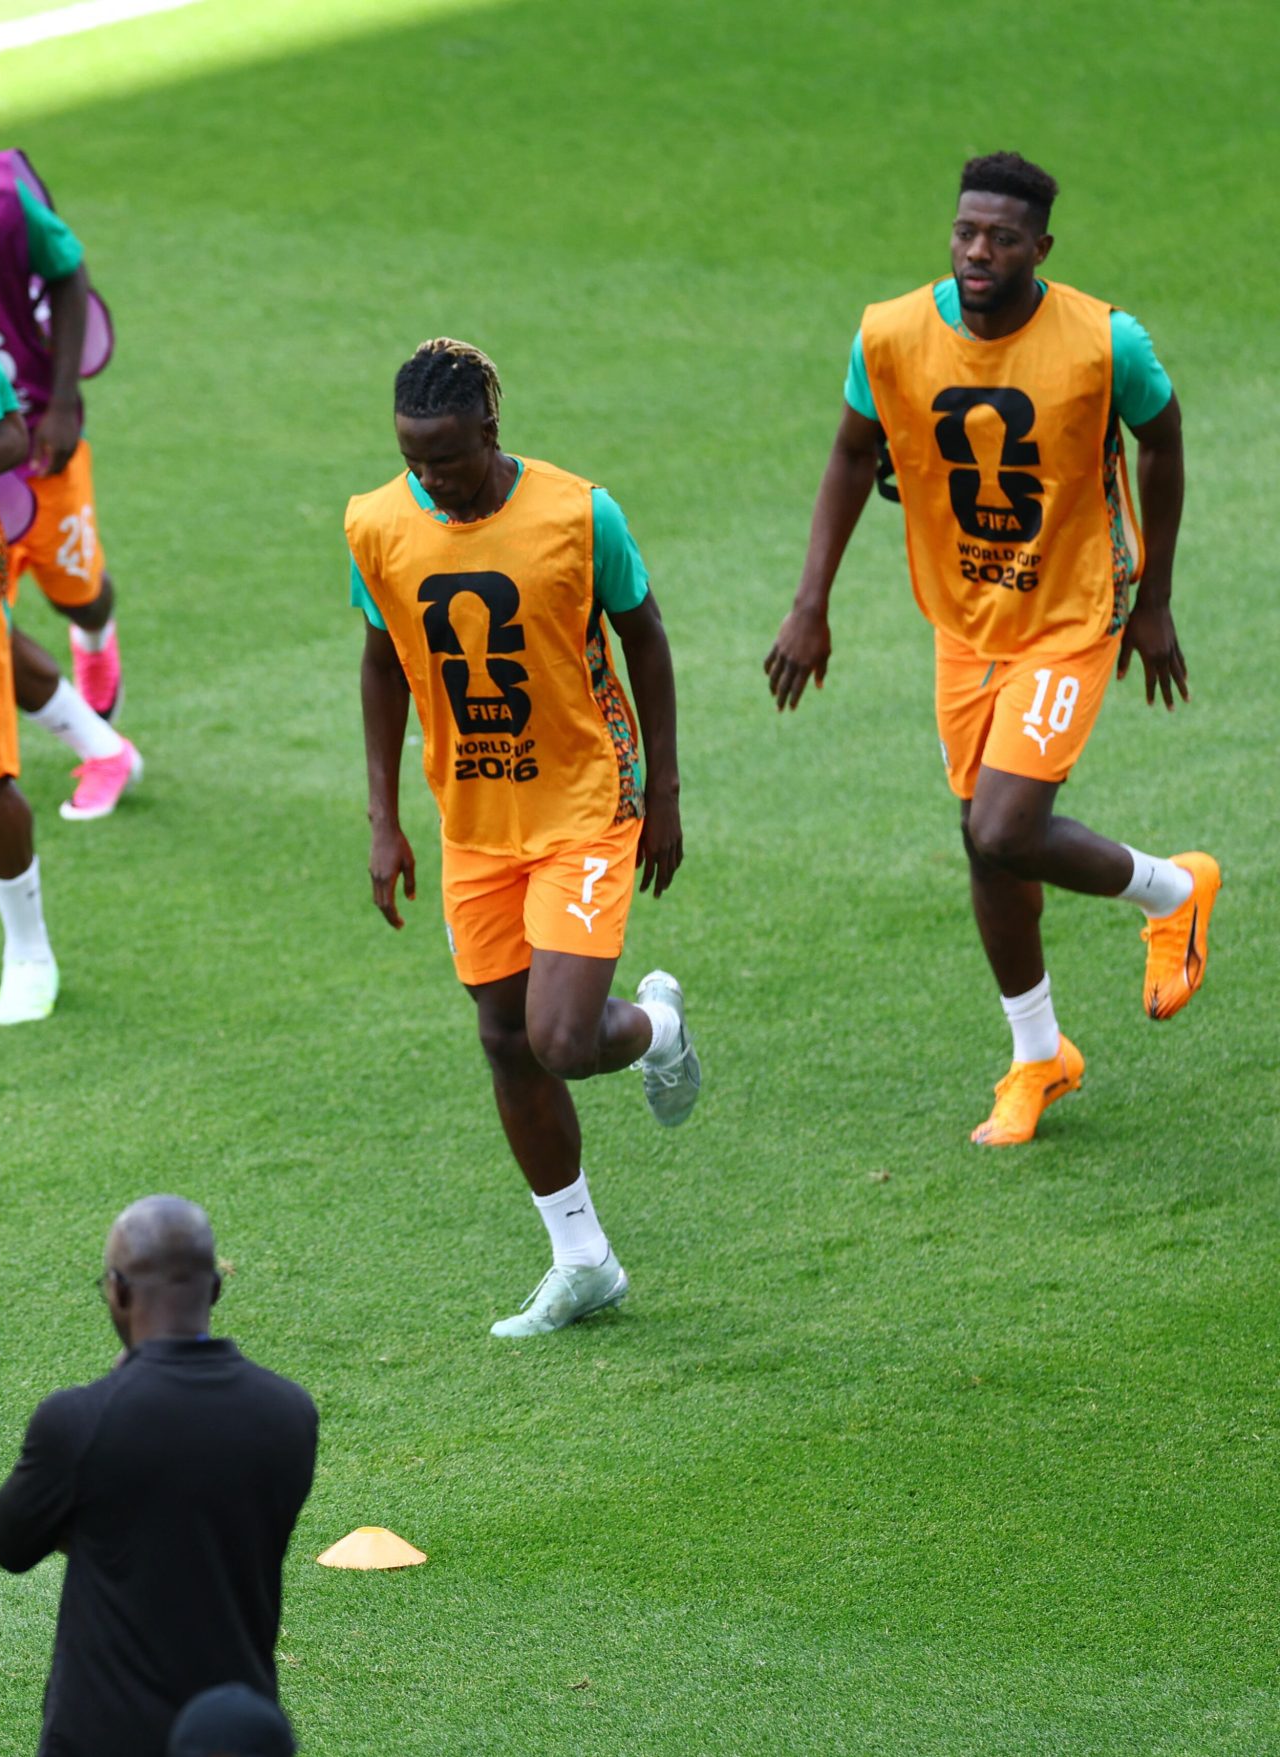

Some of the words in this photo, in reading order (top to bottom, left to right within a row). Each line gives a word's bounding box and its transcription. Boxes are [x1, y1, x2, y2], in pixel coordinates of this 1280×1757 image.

[976, 511, 1022, 532] FIFA
[957, 542, 1015, 561] WORLD
[1017, 551, 1042, 568] CUP
[960, 559, 1040, 592] 2026
[467, 703, 513, 721] FIFA
[1022, 668, 1080, 733] 18
[512, 739, 535, 758] UP
[582, 857, 608, 904] 7
